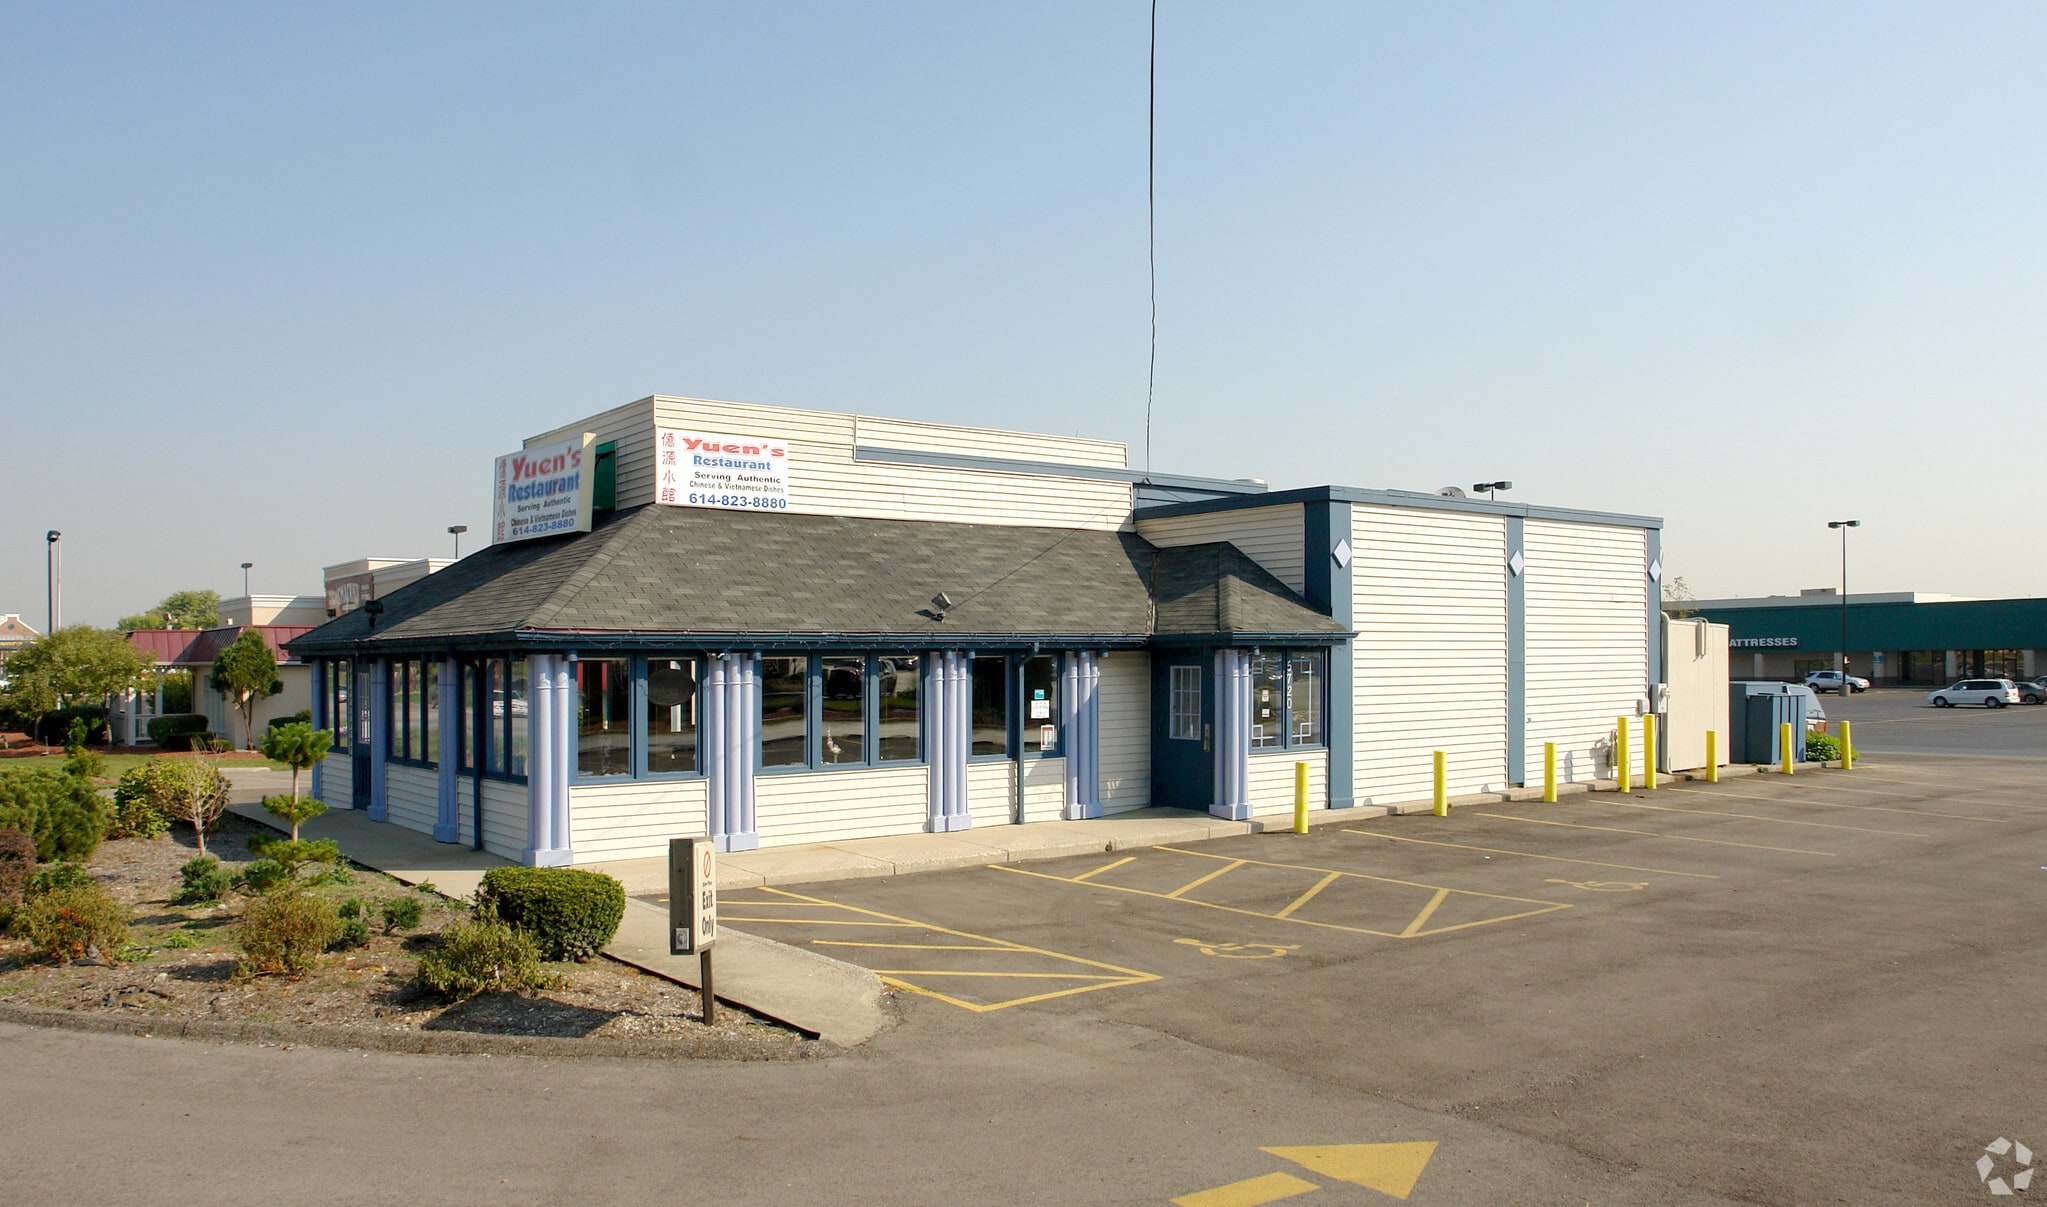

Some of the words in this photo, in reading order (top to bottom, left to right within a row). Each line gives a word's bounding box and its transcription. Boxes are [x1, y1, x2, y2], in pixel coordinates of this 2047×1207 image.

[682, 438, 785, 457] Yuen's
[511, 445, 582, 482] Yuen's
[693, 455, 771, 470] Restaurant
[694, 471, 731, 482] Serving
[737, 474, 781, 484] Authentic
[507, 470, 580, 504] Restaurant
[689, 480, 716, 489] Chinese
[725, 483, 762, 492] Vietnamese
[763, 485, 784, 494] Dishes
[517, 502, 540, 513] Serving
[543, 496, 571, 508] Authentic
[689, 493, 787, 509] 614-823-8880
[511, 517, 529, 527] Chinese
[534, 512, 561, 524] Vietnamese
[561, 508, 577, 518] Dishes
[512, 518, 575, 536] 614-823-8880
[1729, 638, 1798, 646] ATTRESSES
[702, 890, 713, 910] Exit
[702, 915, 714, 937] Only
